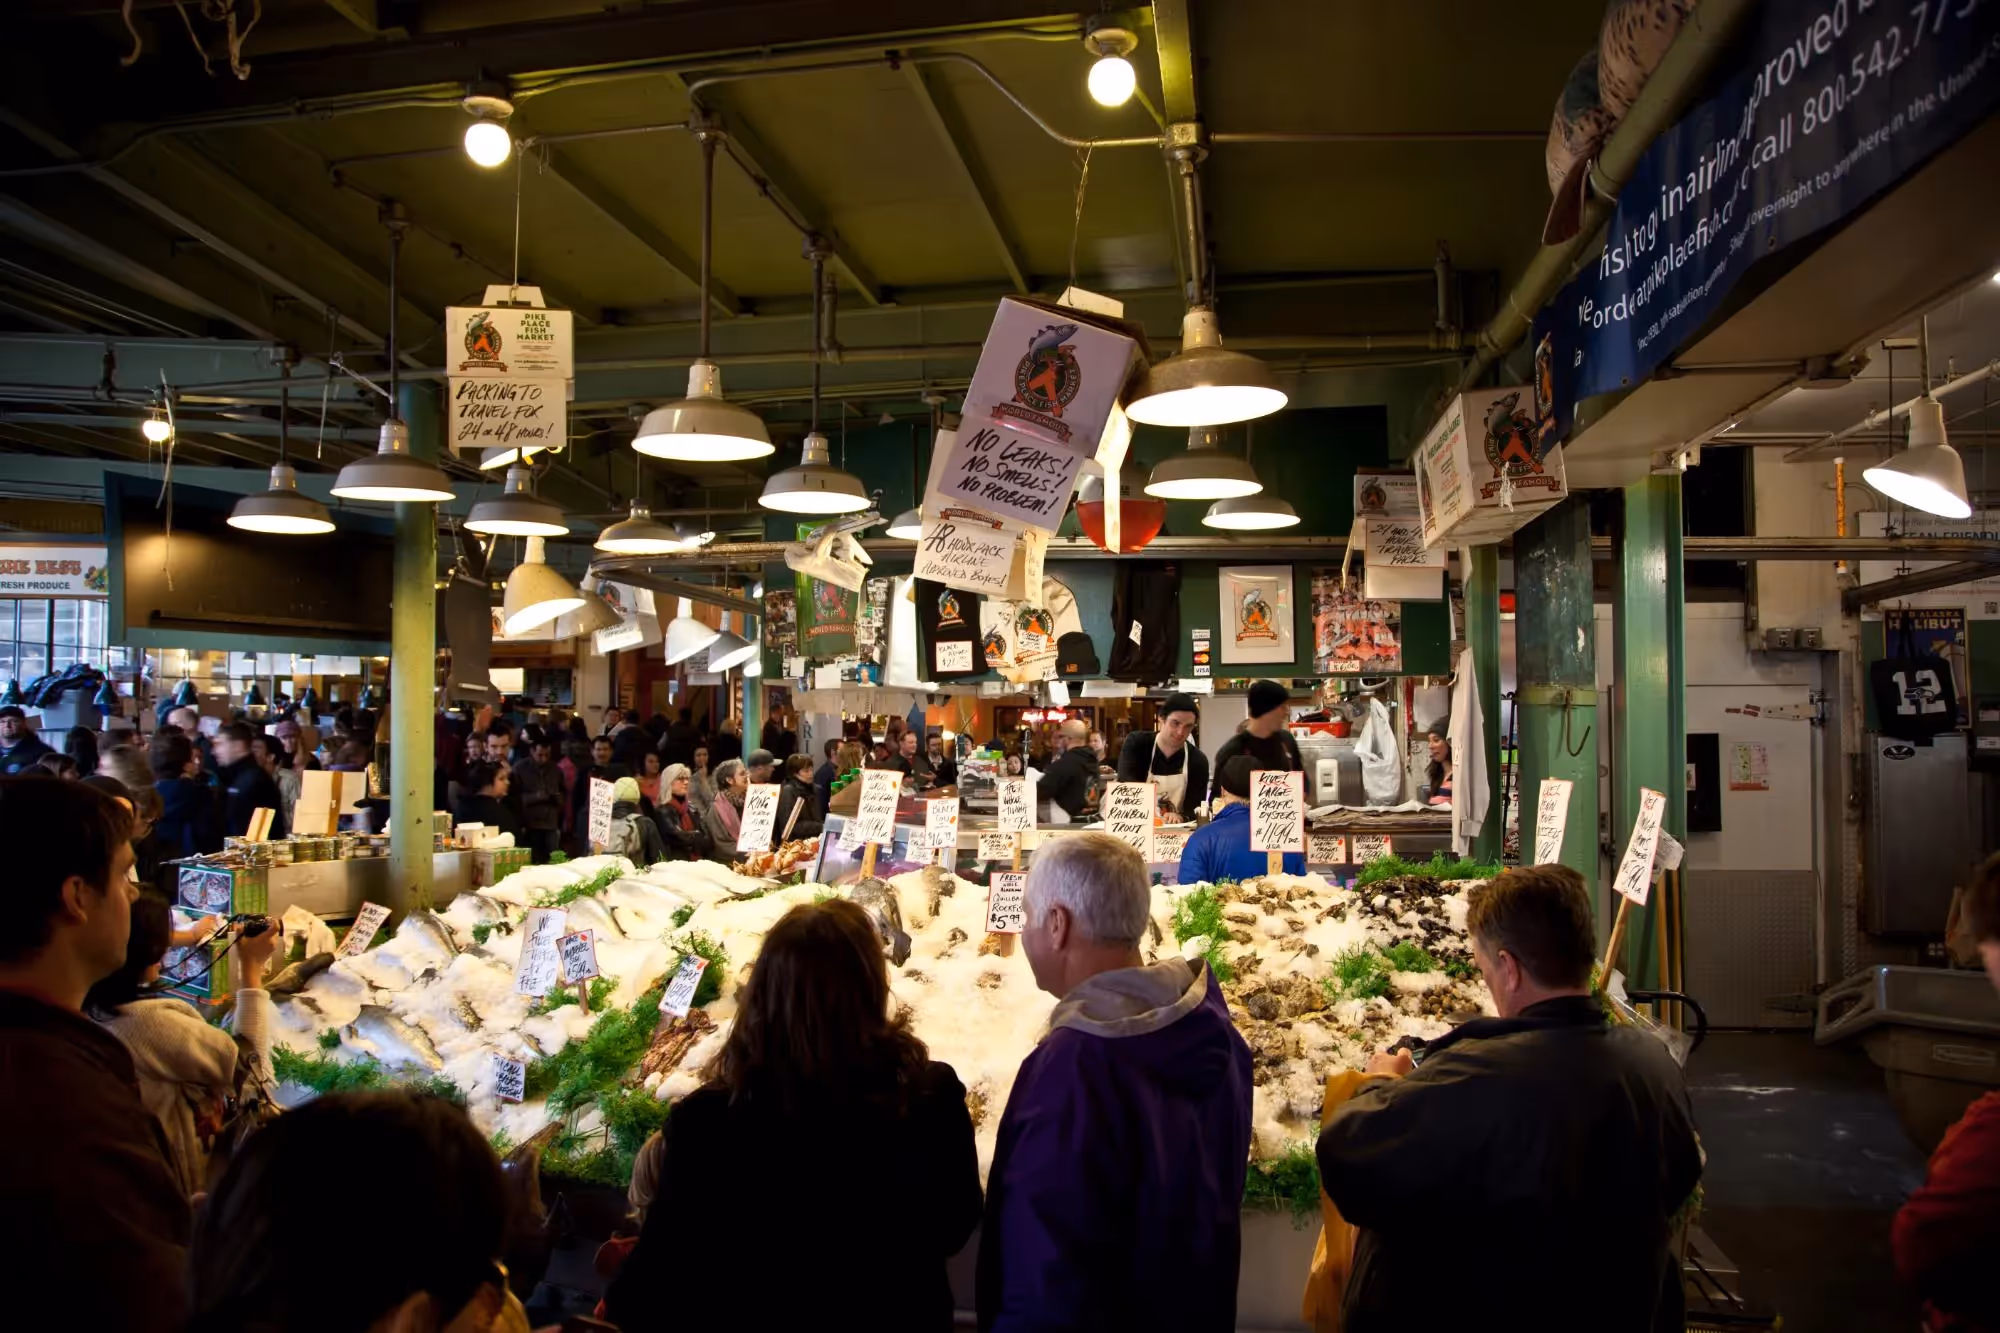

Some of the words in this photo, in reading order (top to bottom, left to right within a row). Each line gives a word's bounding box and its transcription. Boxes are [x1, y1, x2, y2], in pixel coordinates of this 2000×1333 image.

[1751, 112, 1792, 170] call
[1751, 181, 1813, 225] overnight
[1816, 172, 1830, 190] to
[1908, 93, 1936, 122] the
[1661, 184, 1683, 221] in
[456, 380, 517, 404] PACKING
[519, 384, 543, 400] TO
[458, 404, 511, 420] TRAVEL
[1001, 405, 1031, 418] WORLD
[1032, 414, 1067, 434] FAMOUS
[458, 421, 484, 440] 24
[495, 421, 518, 442] 48
[966, 428, 1000, 452] NO
[999, 439, 1074, 477] LEAKS!
[961, 455, 989, 472] NO
[957, 476, 981, 492] NO
[924, 523, 955, 552] 48
[975, 544, 1006, 559] PACK
[27, 581, 70, 589] PRODUCE
[1889, 619, 1962, 630] HLIBUT
[1892, 670, 1947, 715] 12
[1111, 784, 1144, 798] FRESH
[1258, 785, 1292, 797] LARGE
[1257, 799, 1293, 809] PACIFIC
[1107, 807, 1149, 820] RAINBOW
[1259, 810, 1300, 823] OYSTERS
[1112, 821, 1148, 833] TROUT
[991, 903, 1024, 912] ROCKFIS
